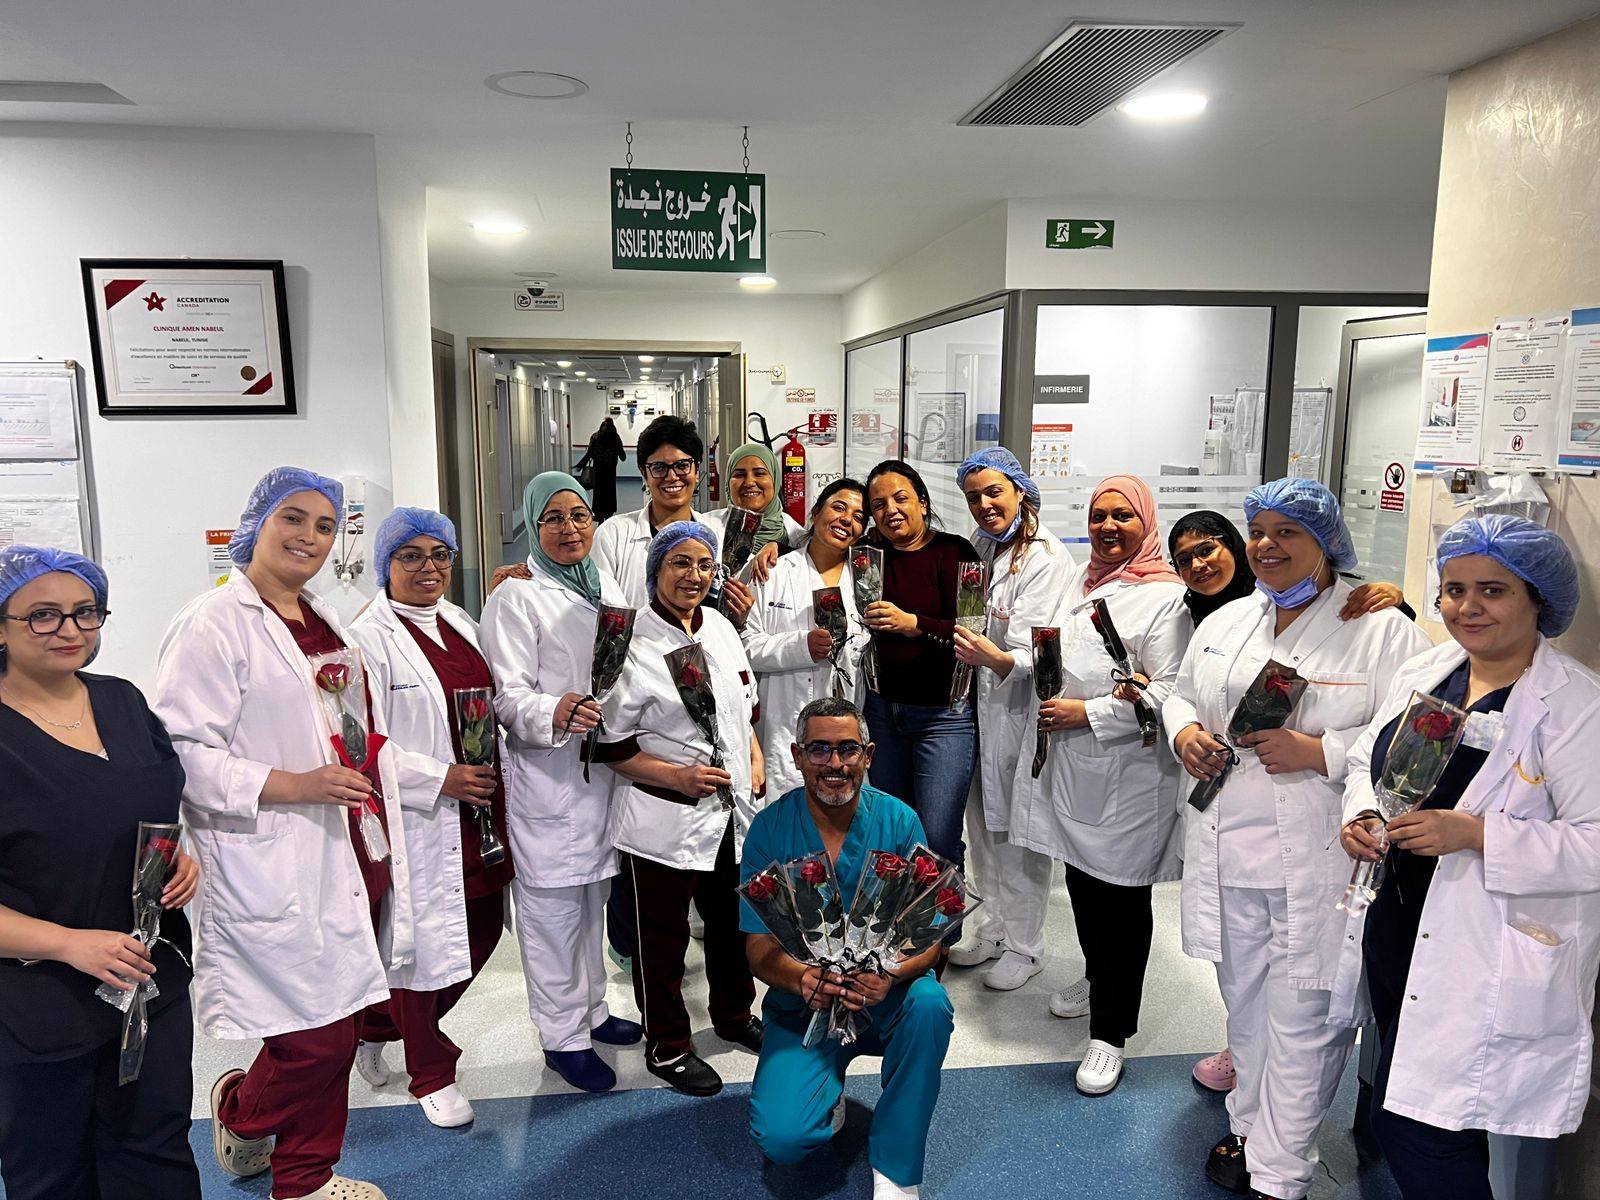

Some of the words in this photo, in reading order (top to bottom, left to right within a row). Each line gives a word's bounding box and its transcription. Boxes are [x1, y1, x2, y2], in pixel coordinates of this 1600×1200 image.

[616, 178, 662, 218] نجدة
[665, 181, 711, 220] خروج
[616, 228, 647, 258] ISSUE
[649, 229, 664, 258] DE
[666, 230, 714, 260] SECOURS
